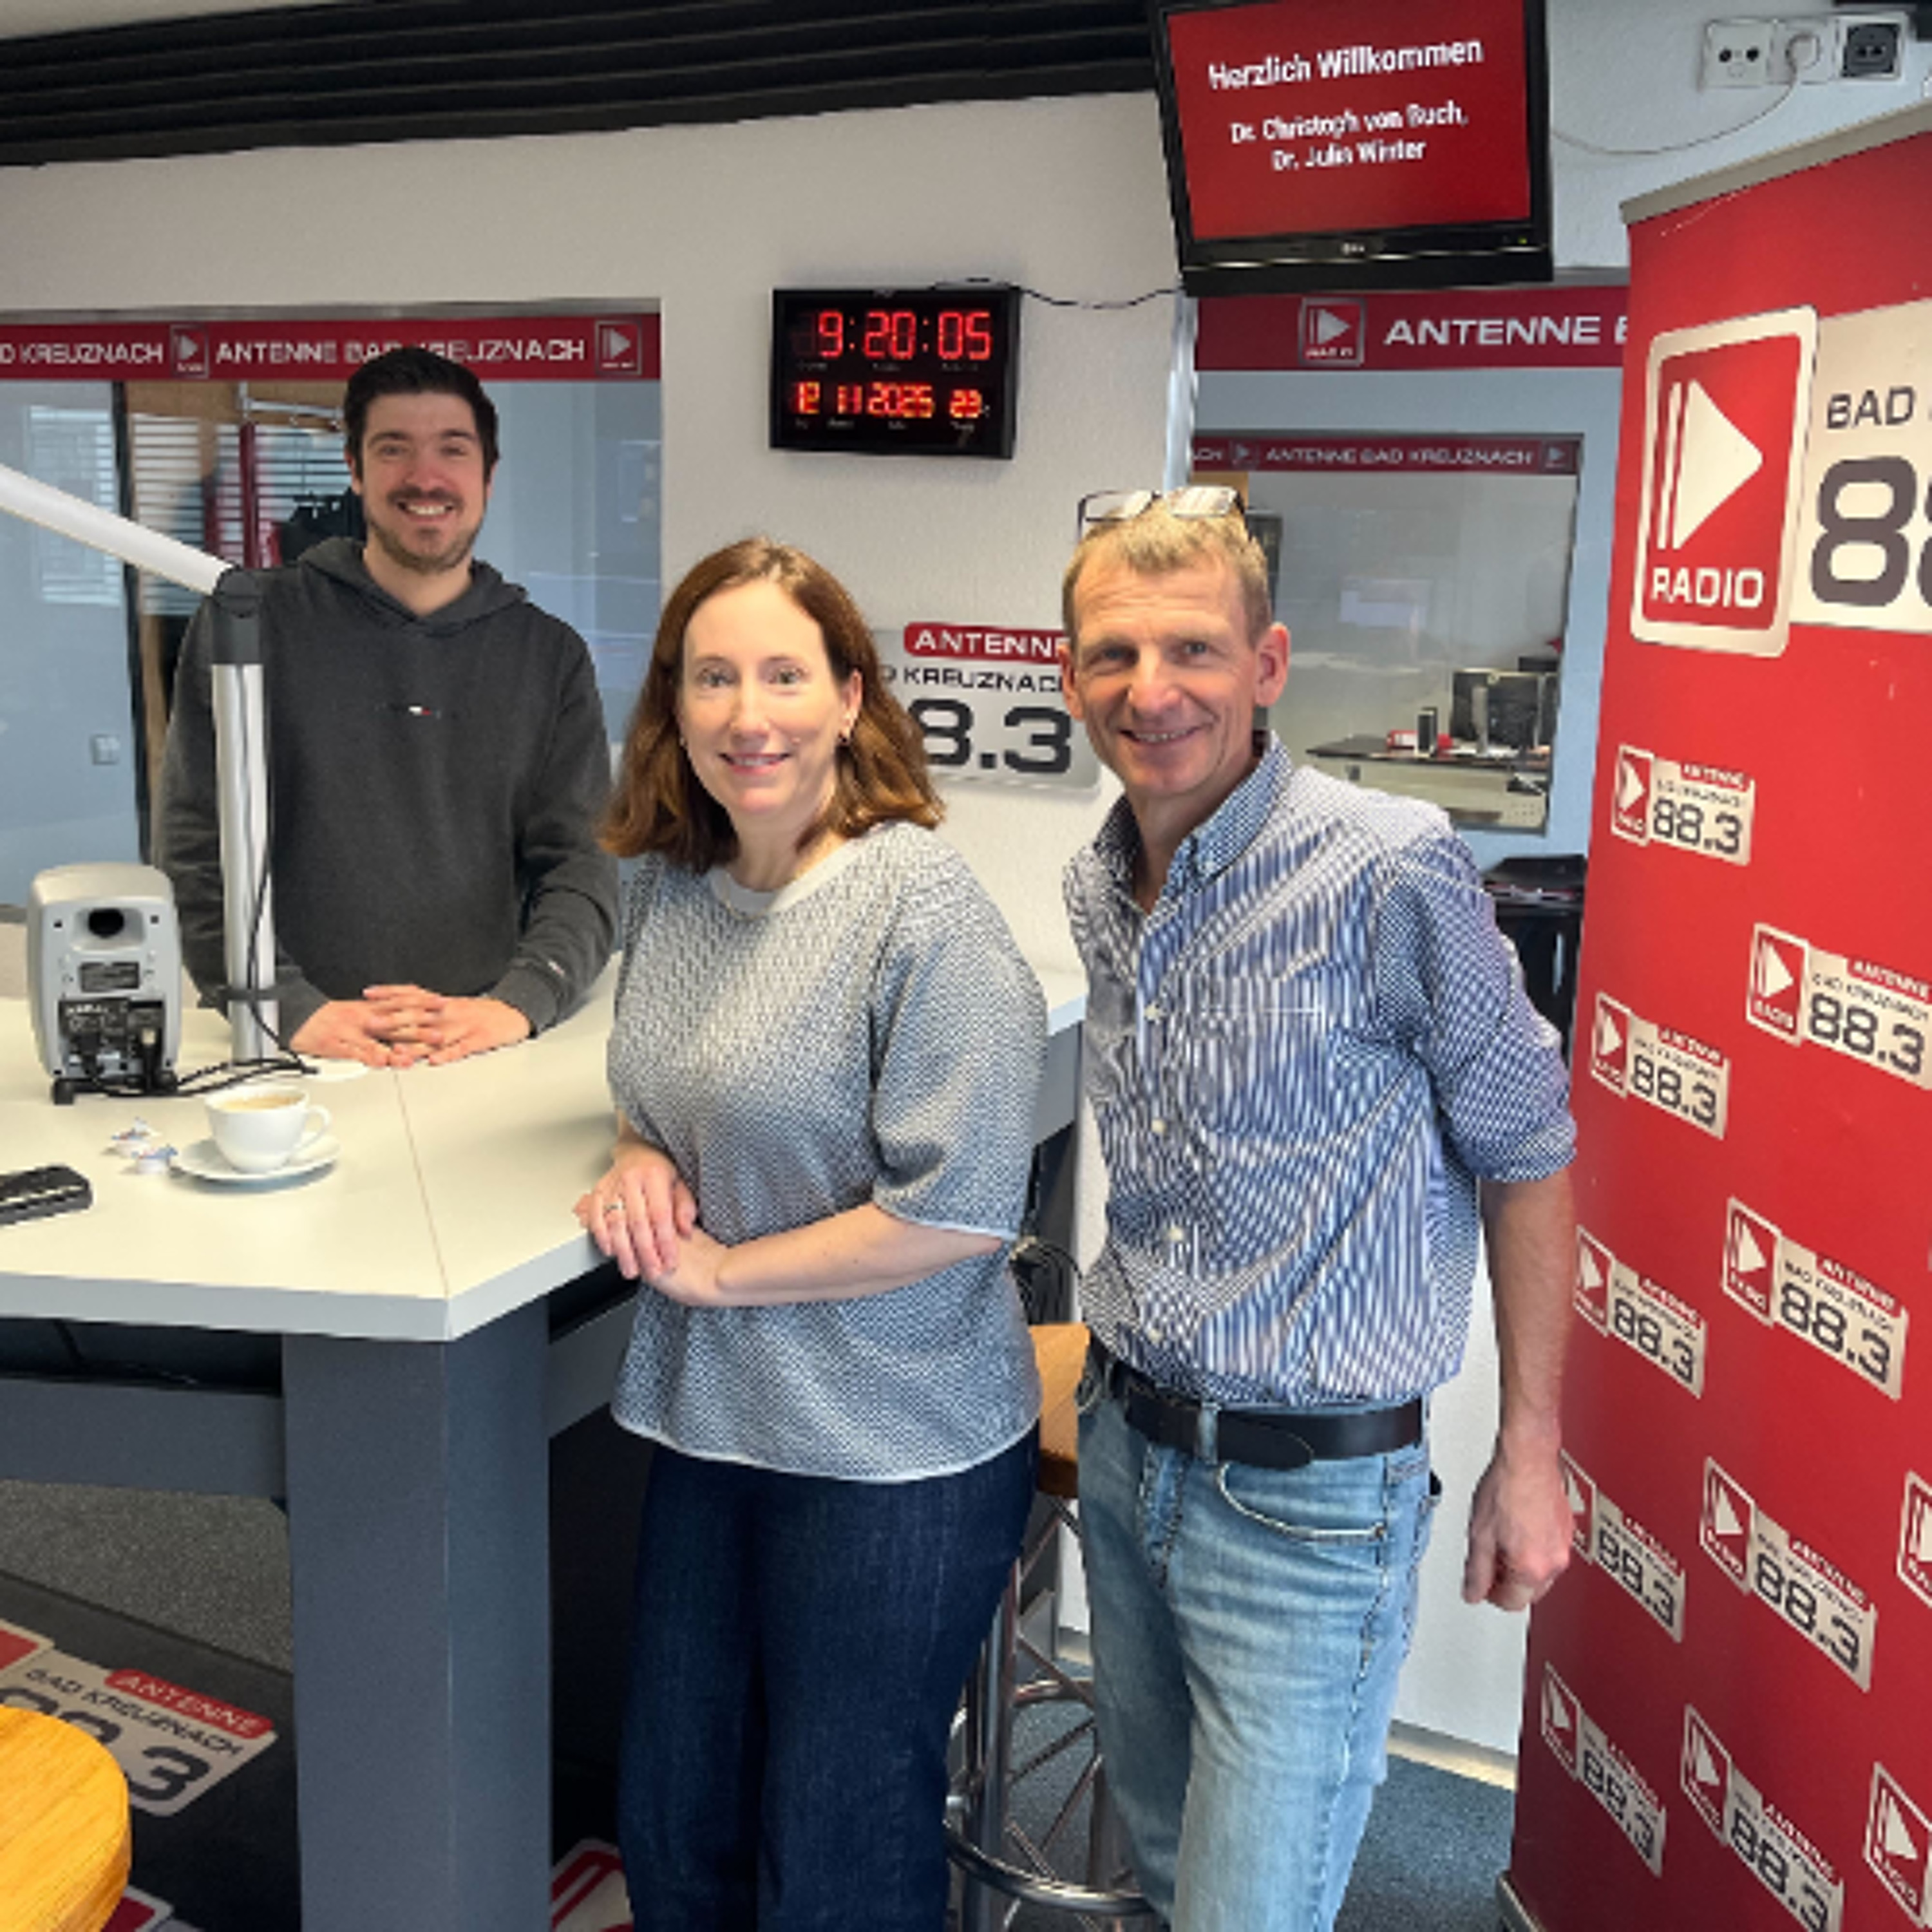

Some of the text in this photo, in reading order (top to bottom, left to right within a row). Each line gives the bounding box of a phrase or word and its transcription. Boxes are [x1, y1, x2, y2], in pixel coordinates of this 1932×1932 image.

[1208, 40, 1483, 90] Herzlich Willkommen
[1231, 122, 1256, 144] Dr.
[1262, 108, 1359, 140] Christoph
[1273, 140, 1427, 171] Dr. Julia Winter
[21, 342, 164, 365] KREUZNACH
[215, 341, 337, 365] ANTENNE
[818, 309, 992, 360] 9:20:05
[1384, 316, 1601, 346] ANTENNE
[1826, 385, 1916, 430] BAD
[1266, 447, 1357, 464] ANTENNE
[1651, 566, 1765, 609] RADIO
[1653, 796, 1743, 855] 88.3
[1809, 992, 1926, 1075] 88.3
[1634, 1053, 1716, 1128] 88.3
[1614, 1298, 1693, 1384] 88.3
[1780, 1281, 1890, 1384] 88.3
[1755, 1551, 1860, 1672] 88.3
